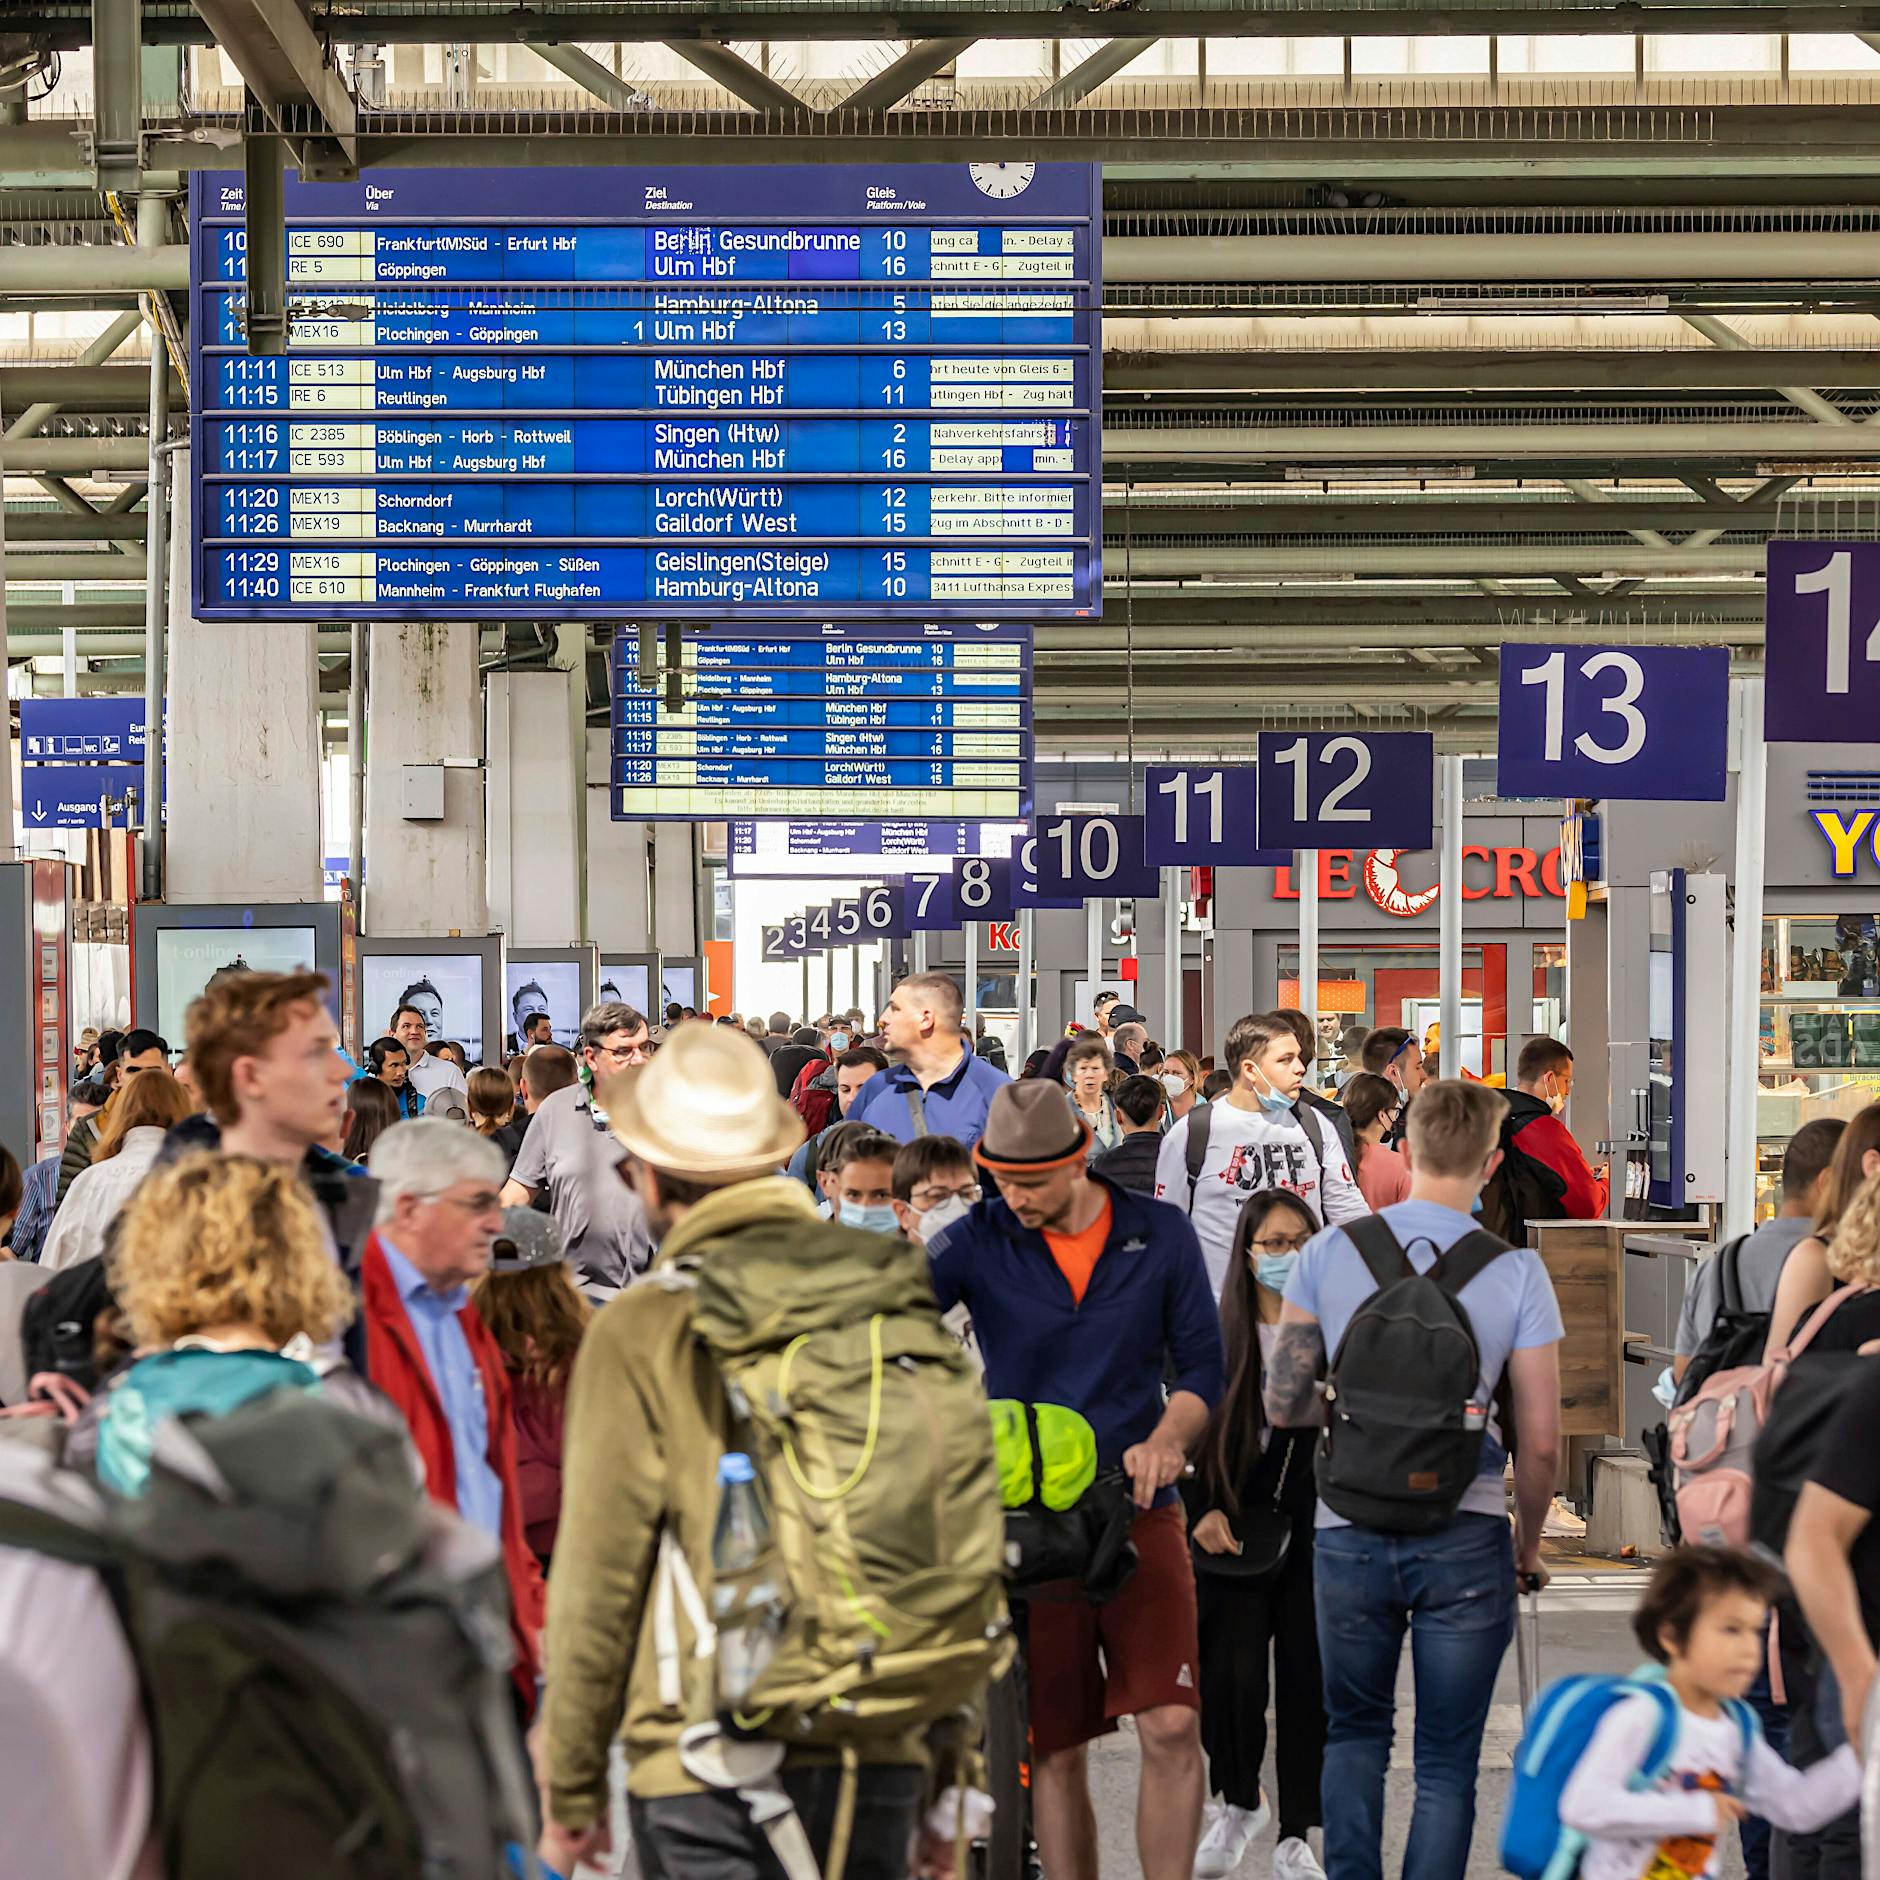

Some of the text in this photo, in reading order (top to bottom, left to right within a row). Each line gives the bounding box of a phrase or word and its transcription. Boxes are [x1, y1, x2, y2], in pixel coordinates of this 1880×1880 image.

[221, 184, 896, 200] Zeit Über Ziel Gleis
[365, 202, 379, 211] Via
[645, 200, 693, 210] Destination
[866, 200, 926, 210] Platform/Voie
[291, 230, 906, 253] ICE 690 Frankfurt(M)Süd Erfurt Hbf Berlin Gesundbrunne 10
[291, 255, 906, 280] RE 5 Göppingen Ulm Hbf 16
[377, 295, 906, 320] Heidelberg Mannheim Hamburg-Altona 5
[291, 325, 339, 338] MEX16
[377, 327, 450, 343] Plochingen
[469, 326, 539, 343] Göppingen
[655, 320, 694, 340] Ulm
[702, 320, 736, 340] Hbf
[881, 320, 906, 341] 13
[224, 359, 276, 380] 11:11
[291, 363, 312, 377] ICE
[317, 363, 344, 377] 513
[377, 365, 404, 380] Ulm
[408, 365, 433, 380] Hbf
[452, 365, 517, 383] Augsburg
[522, 365, 546, 380] Hbf
[654, 359, 744, 380] München
[752, 359, 786, 380] Hbf
[893, 359, 906, 379] 6
[952, 364, 990, 374] heute
[993, 366, 1016, 374] von
[1019, 364, 1049, 374] Gleis
[1052, 364, 1060, 374] 6
[224, 384, 905, 408] 11:15 IRE 6 Reutlingen Tübingen Hbf 11
[224, 423, 906, 448] 11:16 IC 2385 Böblingen Horb Rottweil Singen (Htw) 2
[224, 448, 906, 472] 11:17 ICE 593 Ulm Hbf Augsburg Hbf München Hbf 16
[225, 488, 279, 508] 11:20
[292, 491, 340, 505] MEX13
[378, 493, 453, 508] Schorndorf
[655, 487, 783, 508] Lorch(Württ)
[881, 487, 906, 508] 12
[984, 492, 1015, 503] Bitte
[225, 513, 1062, 536] 11:26 MEX19 Backnang Murrhardt Gaildorf West 15 Zug im Abschnitt B D
[225, 551, 906, 576] 11:29 MEX16 Plochingen Göppingen Süßen Geislingen(Steige) 15
[225, 577, 279, 597] 11:40
[292, 581, 313, 594] ICE
[319, 581, 345, 594] 610
[378, 583, 446, 598] Mannheim
[465, 583, 530, 598] Frankfurt
[534, 583, 601, 600] Flughafen
[655, 577, 819, 602] Hamburg-Altona
[881, 576, 906, 597] 10
[933, 582, 960, 592] 3411
[963, 582, 1025, 592] Lufthansa
[1794, 550, 1880, 694] 1
[825, 642, 853, 654] Berlin
[825, 673, 903, 685] Hamburg-Altona
[626, 700, 652, 711] 11:11
[626, 712, 652, 723] 11:15
[1521, 651, 1647, 764] 13
[825, 733, 856, 745] Singen
[865, 773, 892, 785] West
[1274, 736, 1373, 822] 12
[57, 801, 98, 814] Ausgang
[1158, 771, 1223, 843] 11
[1047, 817, 1119, 880] 10
[1808, 808, 1880, 879] Y
[960, 858, 993, 908] 8
[866, 887, 893, 928] 6
[912, 874, 941, 918] 7
[810, 907, 832, 940] 4
[837, 899, 860, 935] 5
[766, 926, 785, 955] 2
[788, 916, 806, 950] 3
